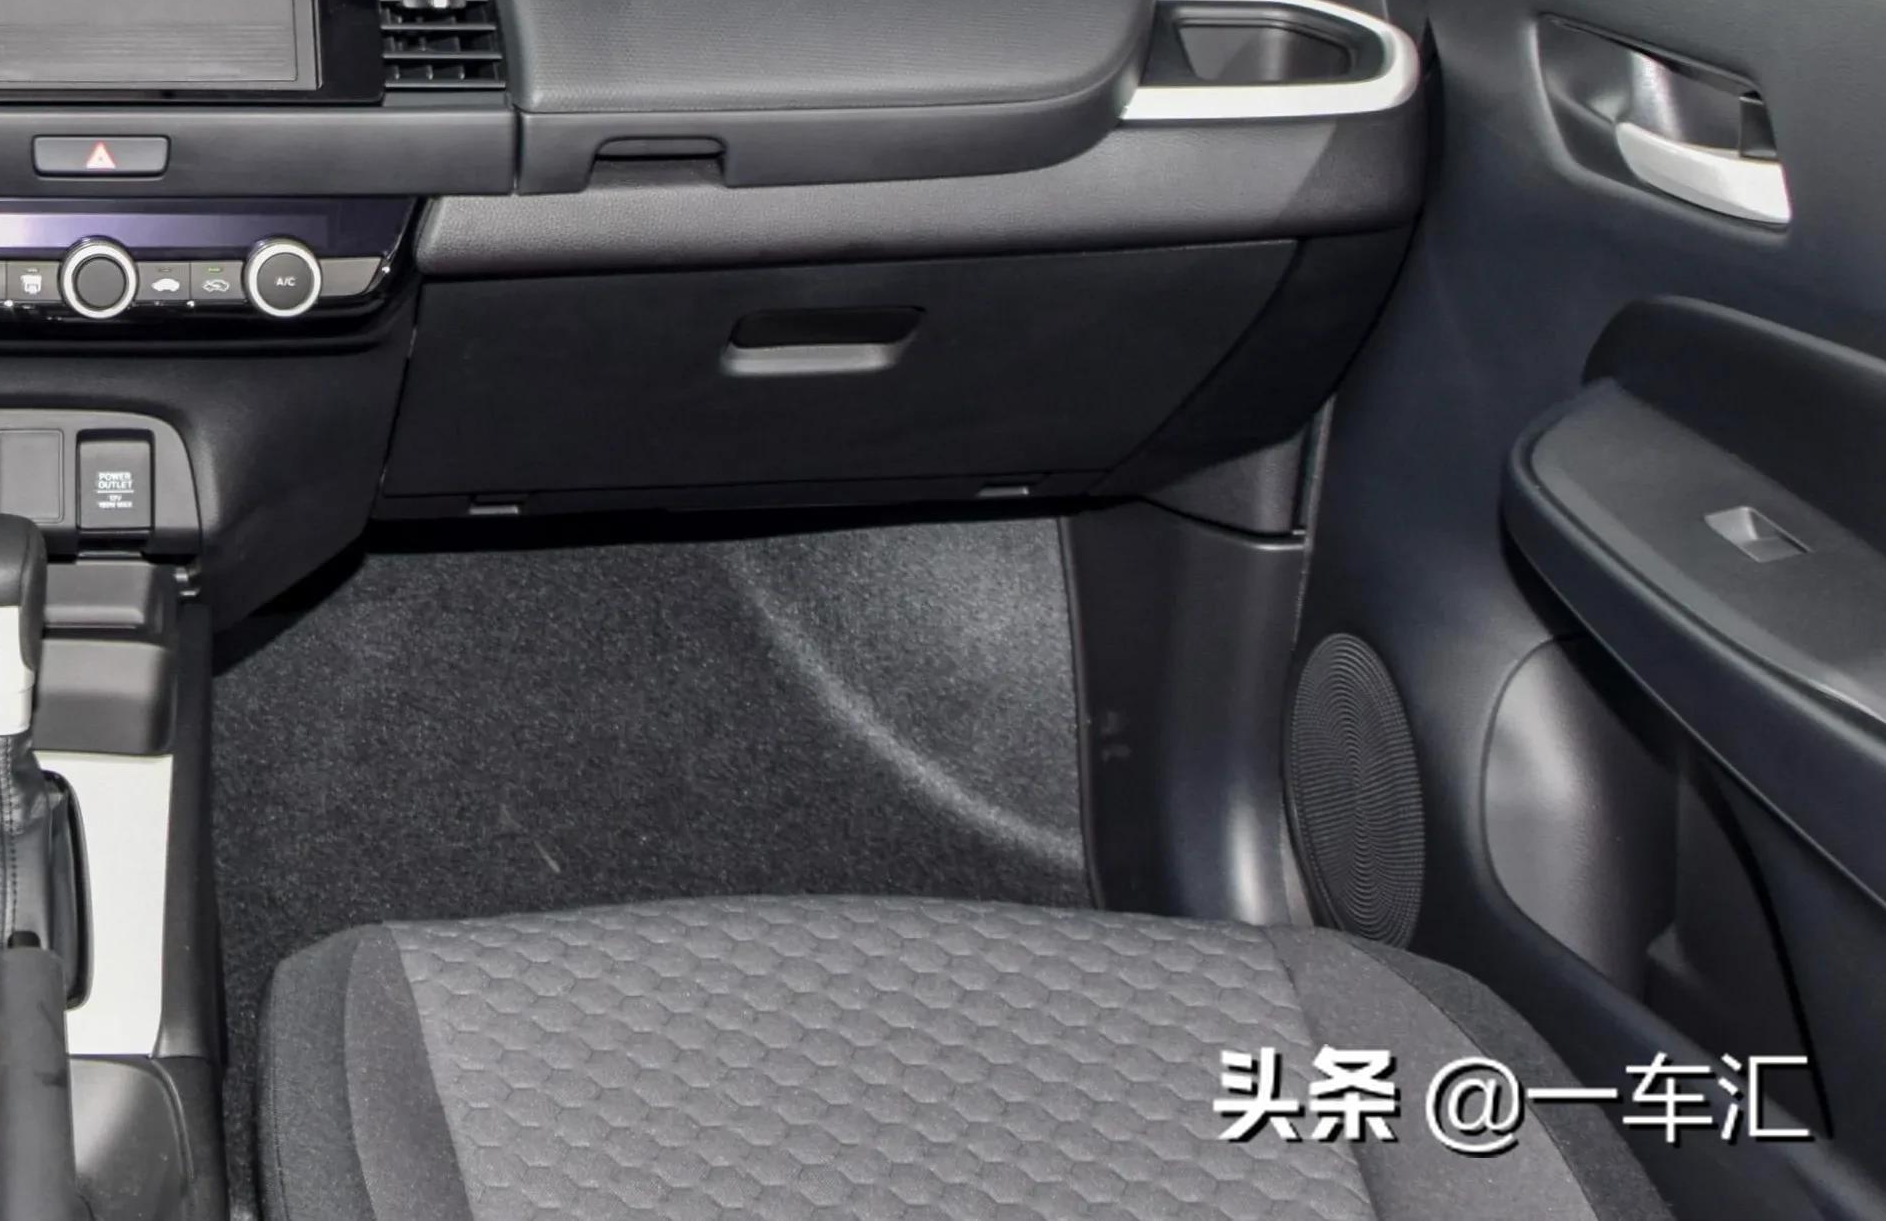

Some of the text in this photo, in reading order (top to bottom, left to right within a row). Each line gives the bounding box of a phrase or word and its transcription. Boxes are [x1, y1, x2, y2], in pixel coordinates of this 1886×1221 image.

[276, 277, 296, 287] A/C
[98, 471, 132, 481] POWER
[98, 481, 133, 489] OUTLET
